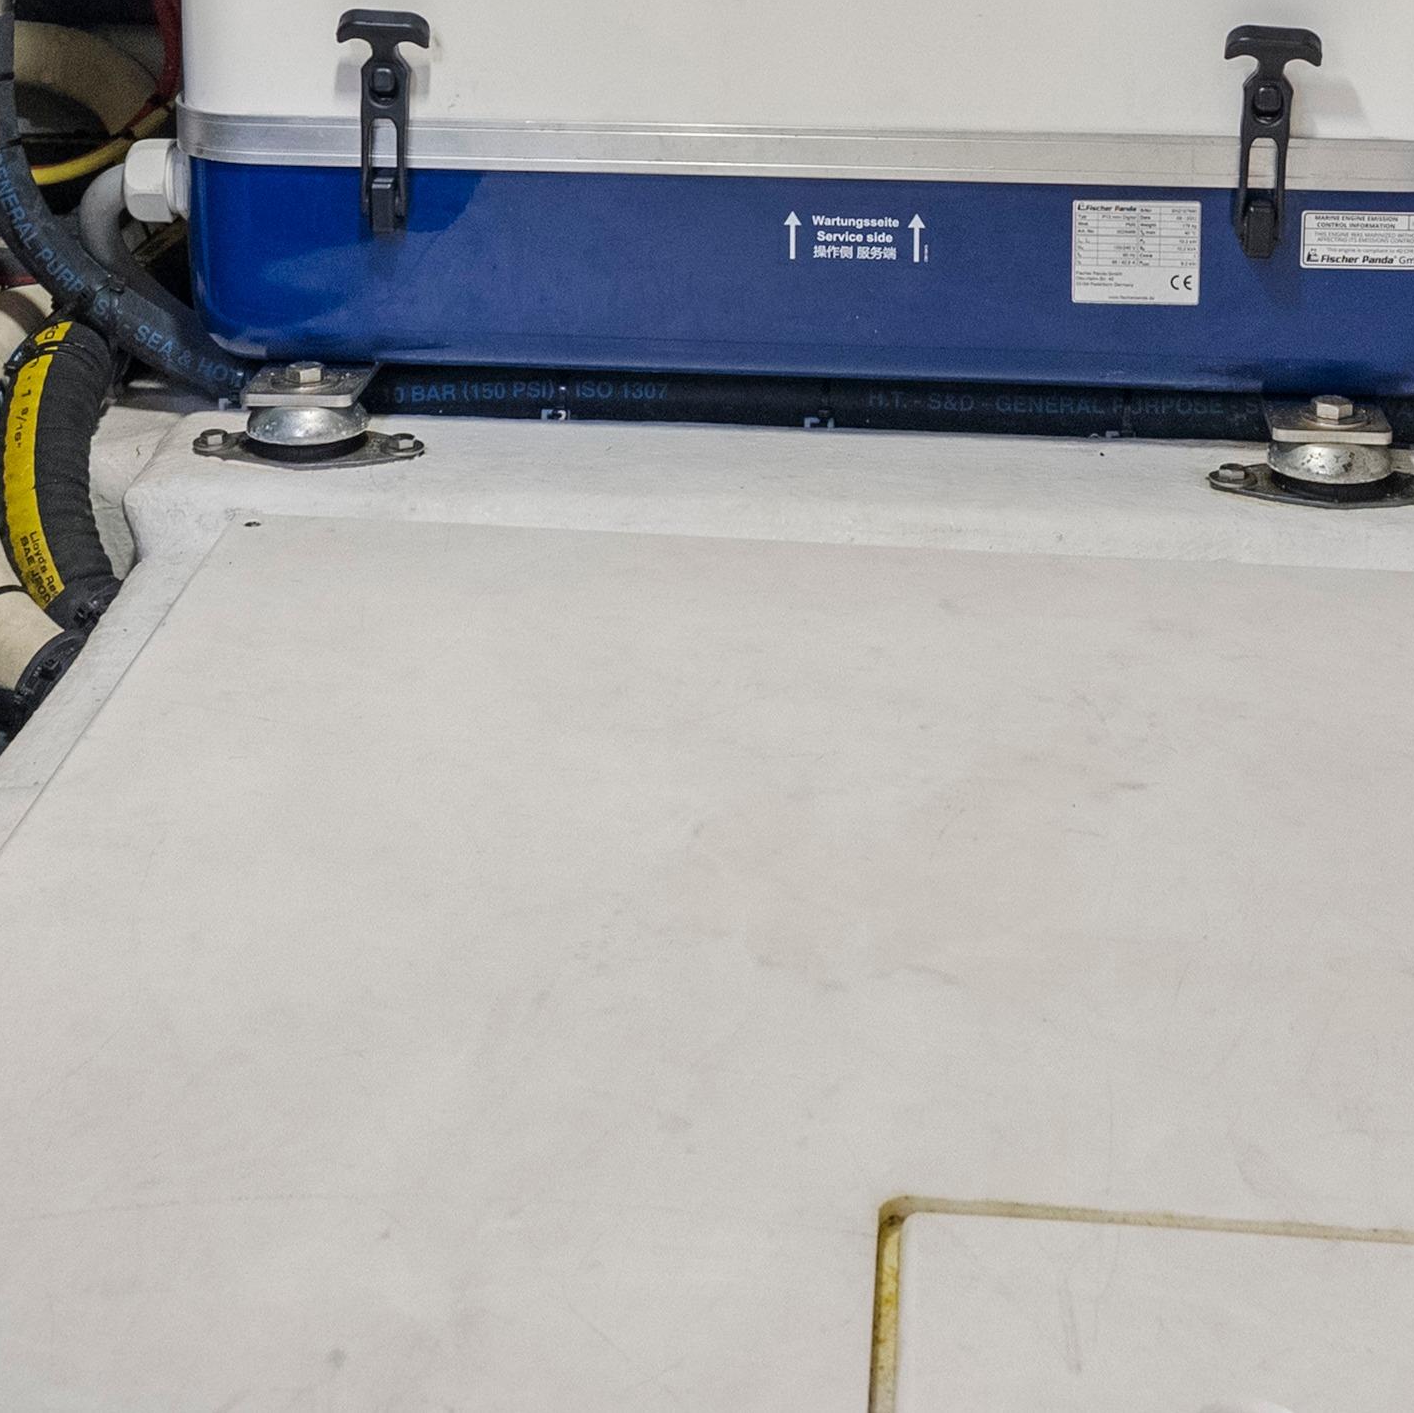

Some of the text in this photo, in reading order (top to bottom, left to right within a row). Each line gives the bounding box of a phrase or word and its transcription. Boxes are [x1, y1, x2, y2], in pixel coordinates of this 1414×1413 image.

[1085, 204, 1113, 212] Fischer
[811, 214, 900, 229] Wartungsseite
[816, 230, 893, 243] Service side
[1320, 255, 1358, 264] Fischer
[135, 324, 177, 358] SEA
[410, 385, 457, 403] BAR
[463, 383, 507, 401] (150
[511, 382, 554, 400] PSI)
[575, 382, 612, 399] ISO
[928, 394, 975, 411] S&D
[995, 395, 1106, 415] GENERAL
